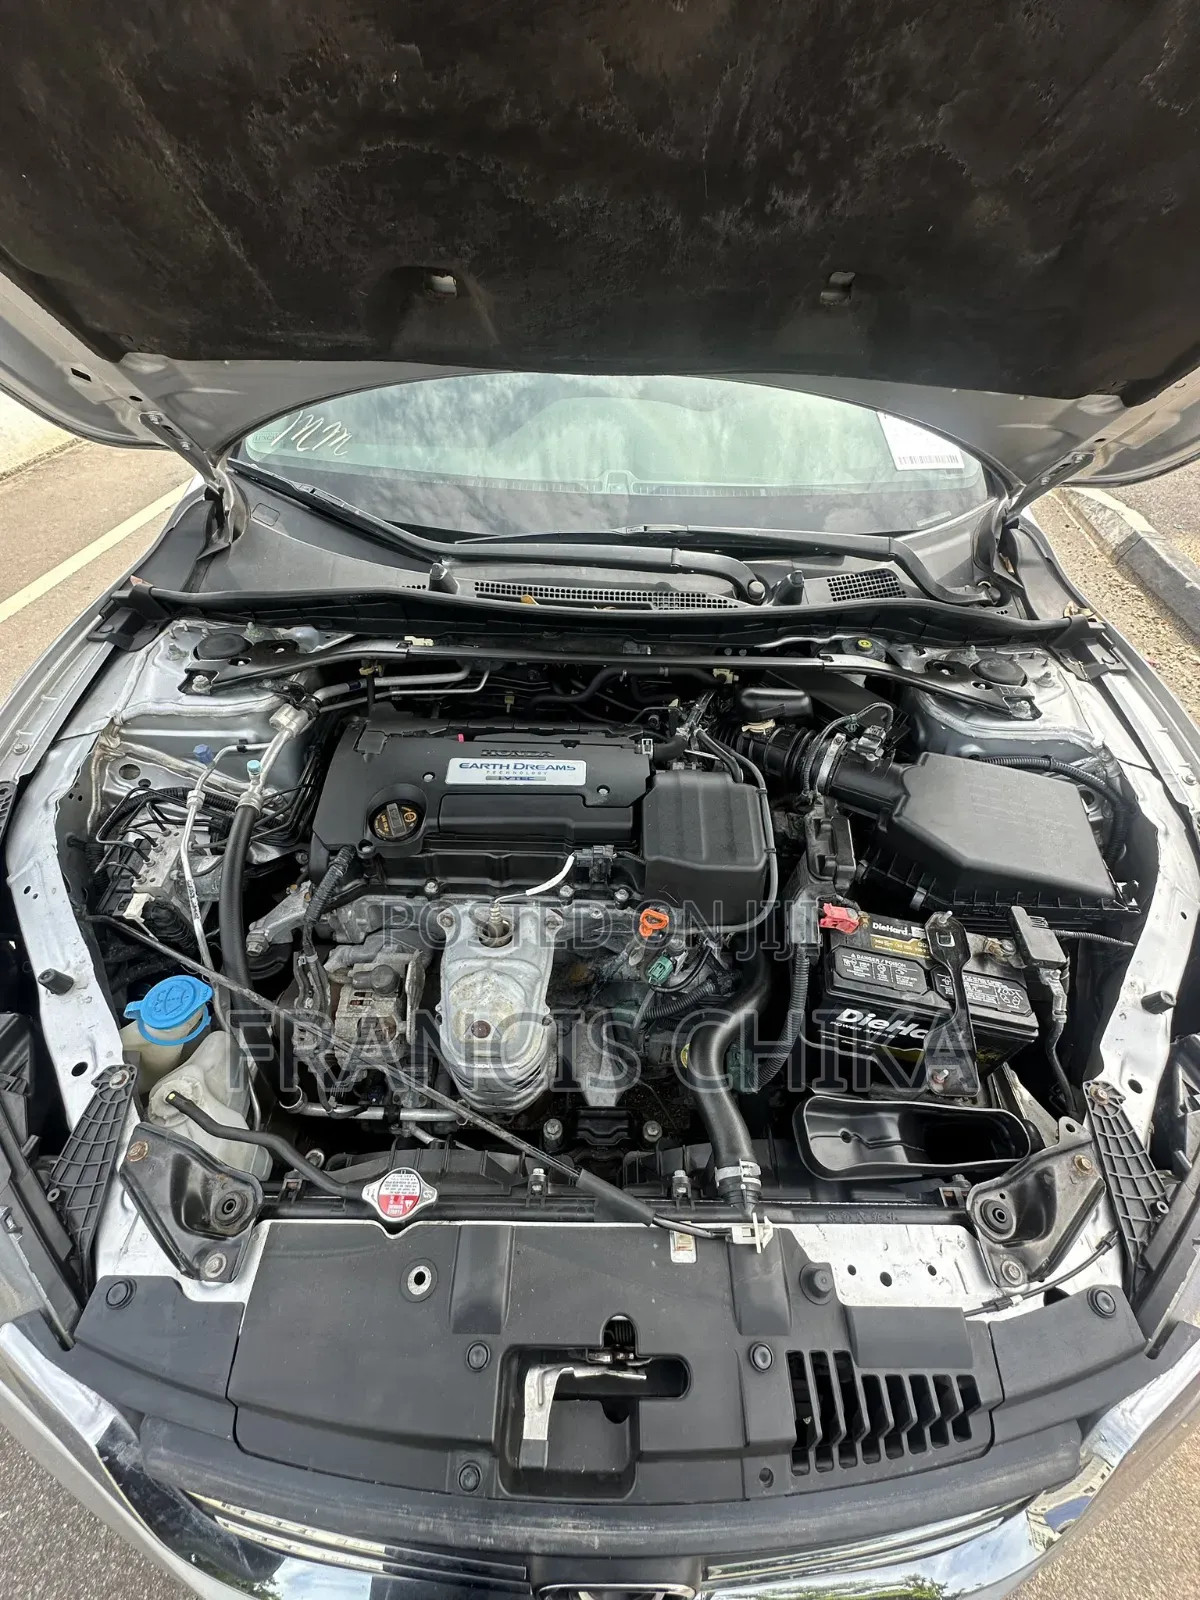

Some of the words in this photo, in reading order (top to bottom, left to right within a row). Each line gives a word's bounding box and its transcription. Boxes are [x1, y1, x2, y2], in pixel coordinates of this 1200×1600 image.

[481, 749, 555, 757] HONDA
[459, 762, 511, 770] EARTH
[872, 921, 909, 936] DieHard
[856, 953, 881, 963] DANGER
[884, 959, 907, 968] POISON
